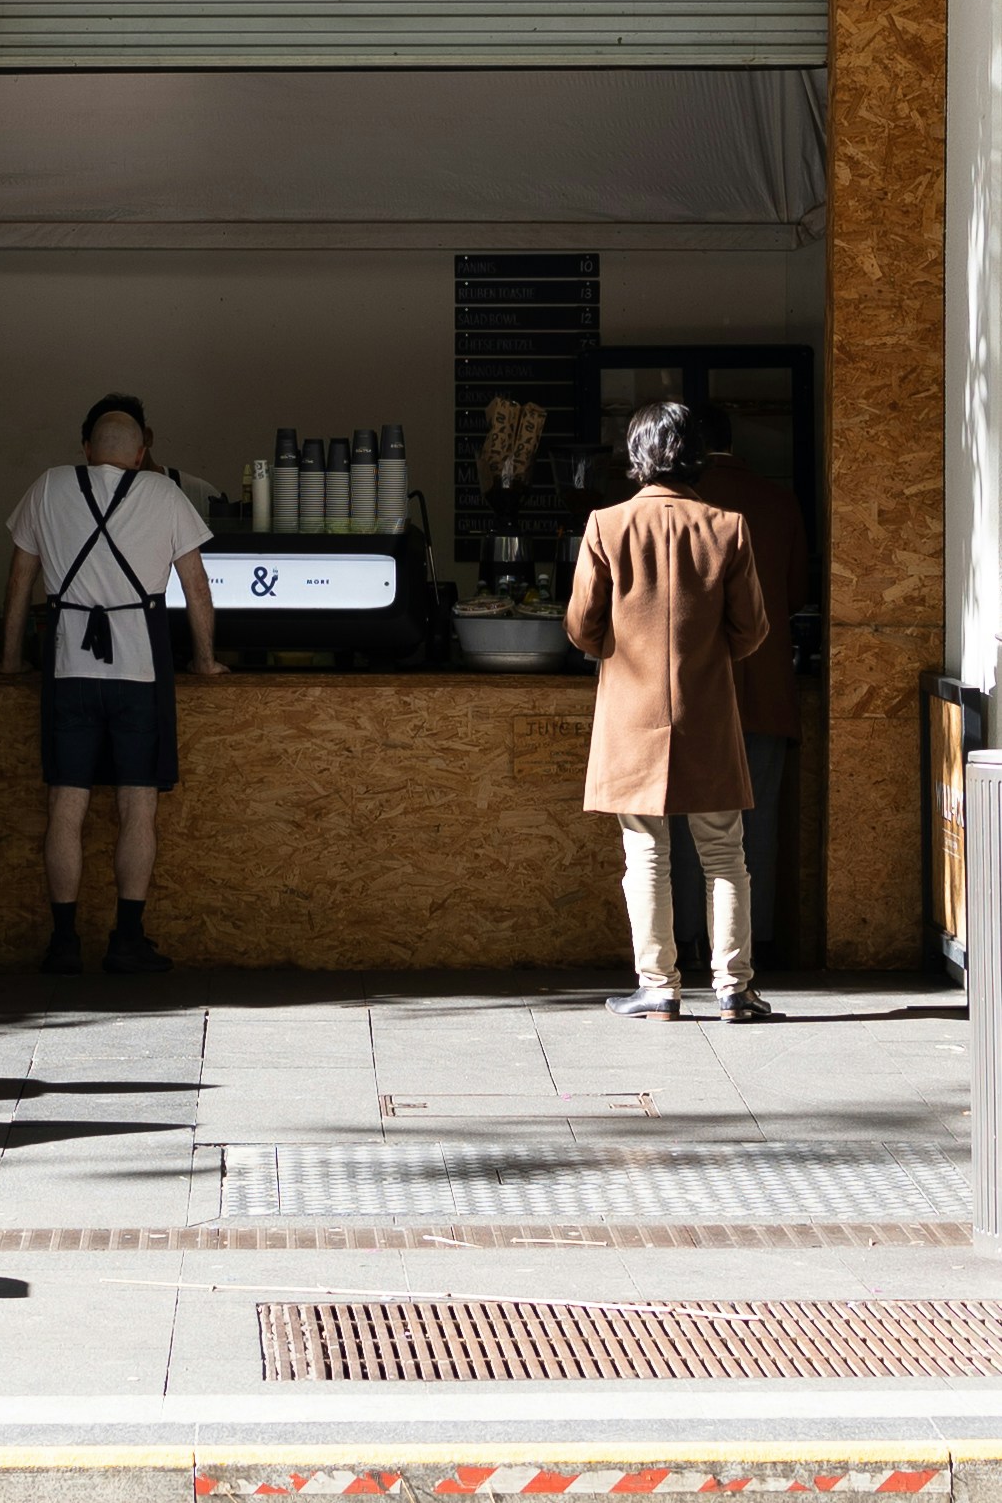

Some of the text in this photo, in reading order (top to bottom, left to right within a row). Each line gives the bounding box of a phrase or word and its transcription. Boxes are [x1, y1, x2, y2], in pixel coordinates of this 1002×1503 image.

[457, 260, 594, 274] PANINIS 10
[458, 287, 593, 300] REUBEN TOASTIE 13
[457, 312, 593, 326] SALAD BOWL 12
[458, 338, 495, 351] CHEESE
[496, 338, 536, 351] PRETZEL
[457, 364, 535, 378] GRANOLA BOWL
[250, 565, 279, 597] &
